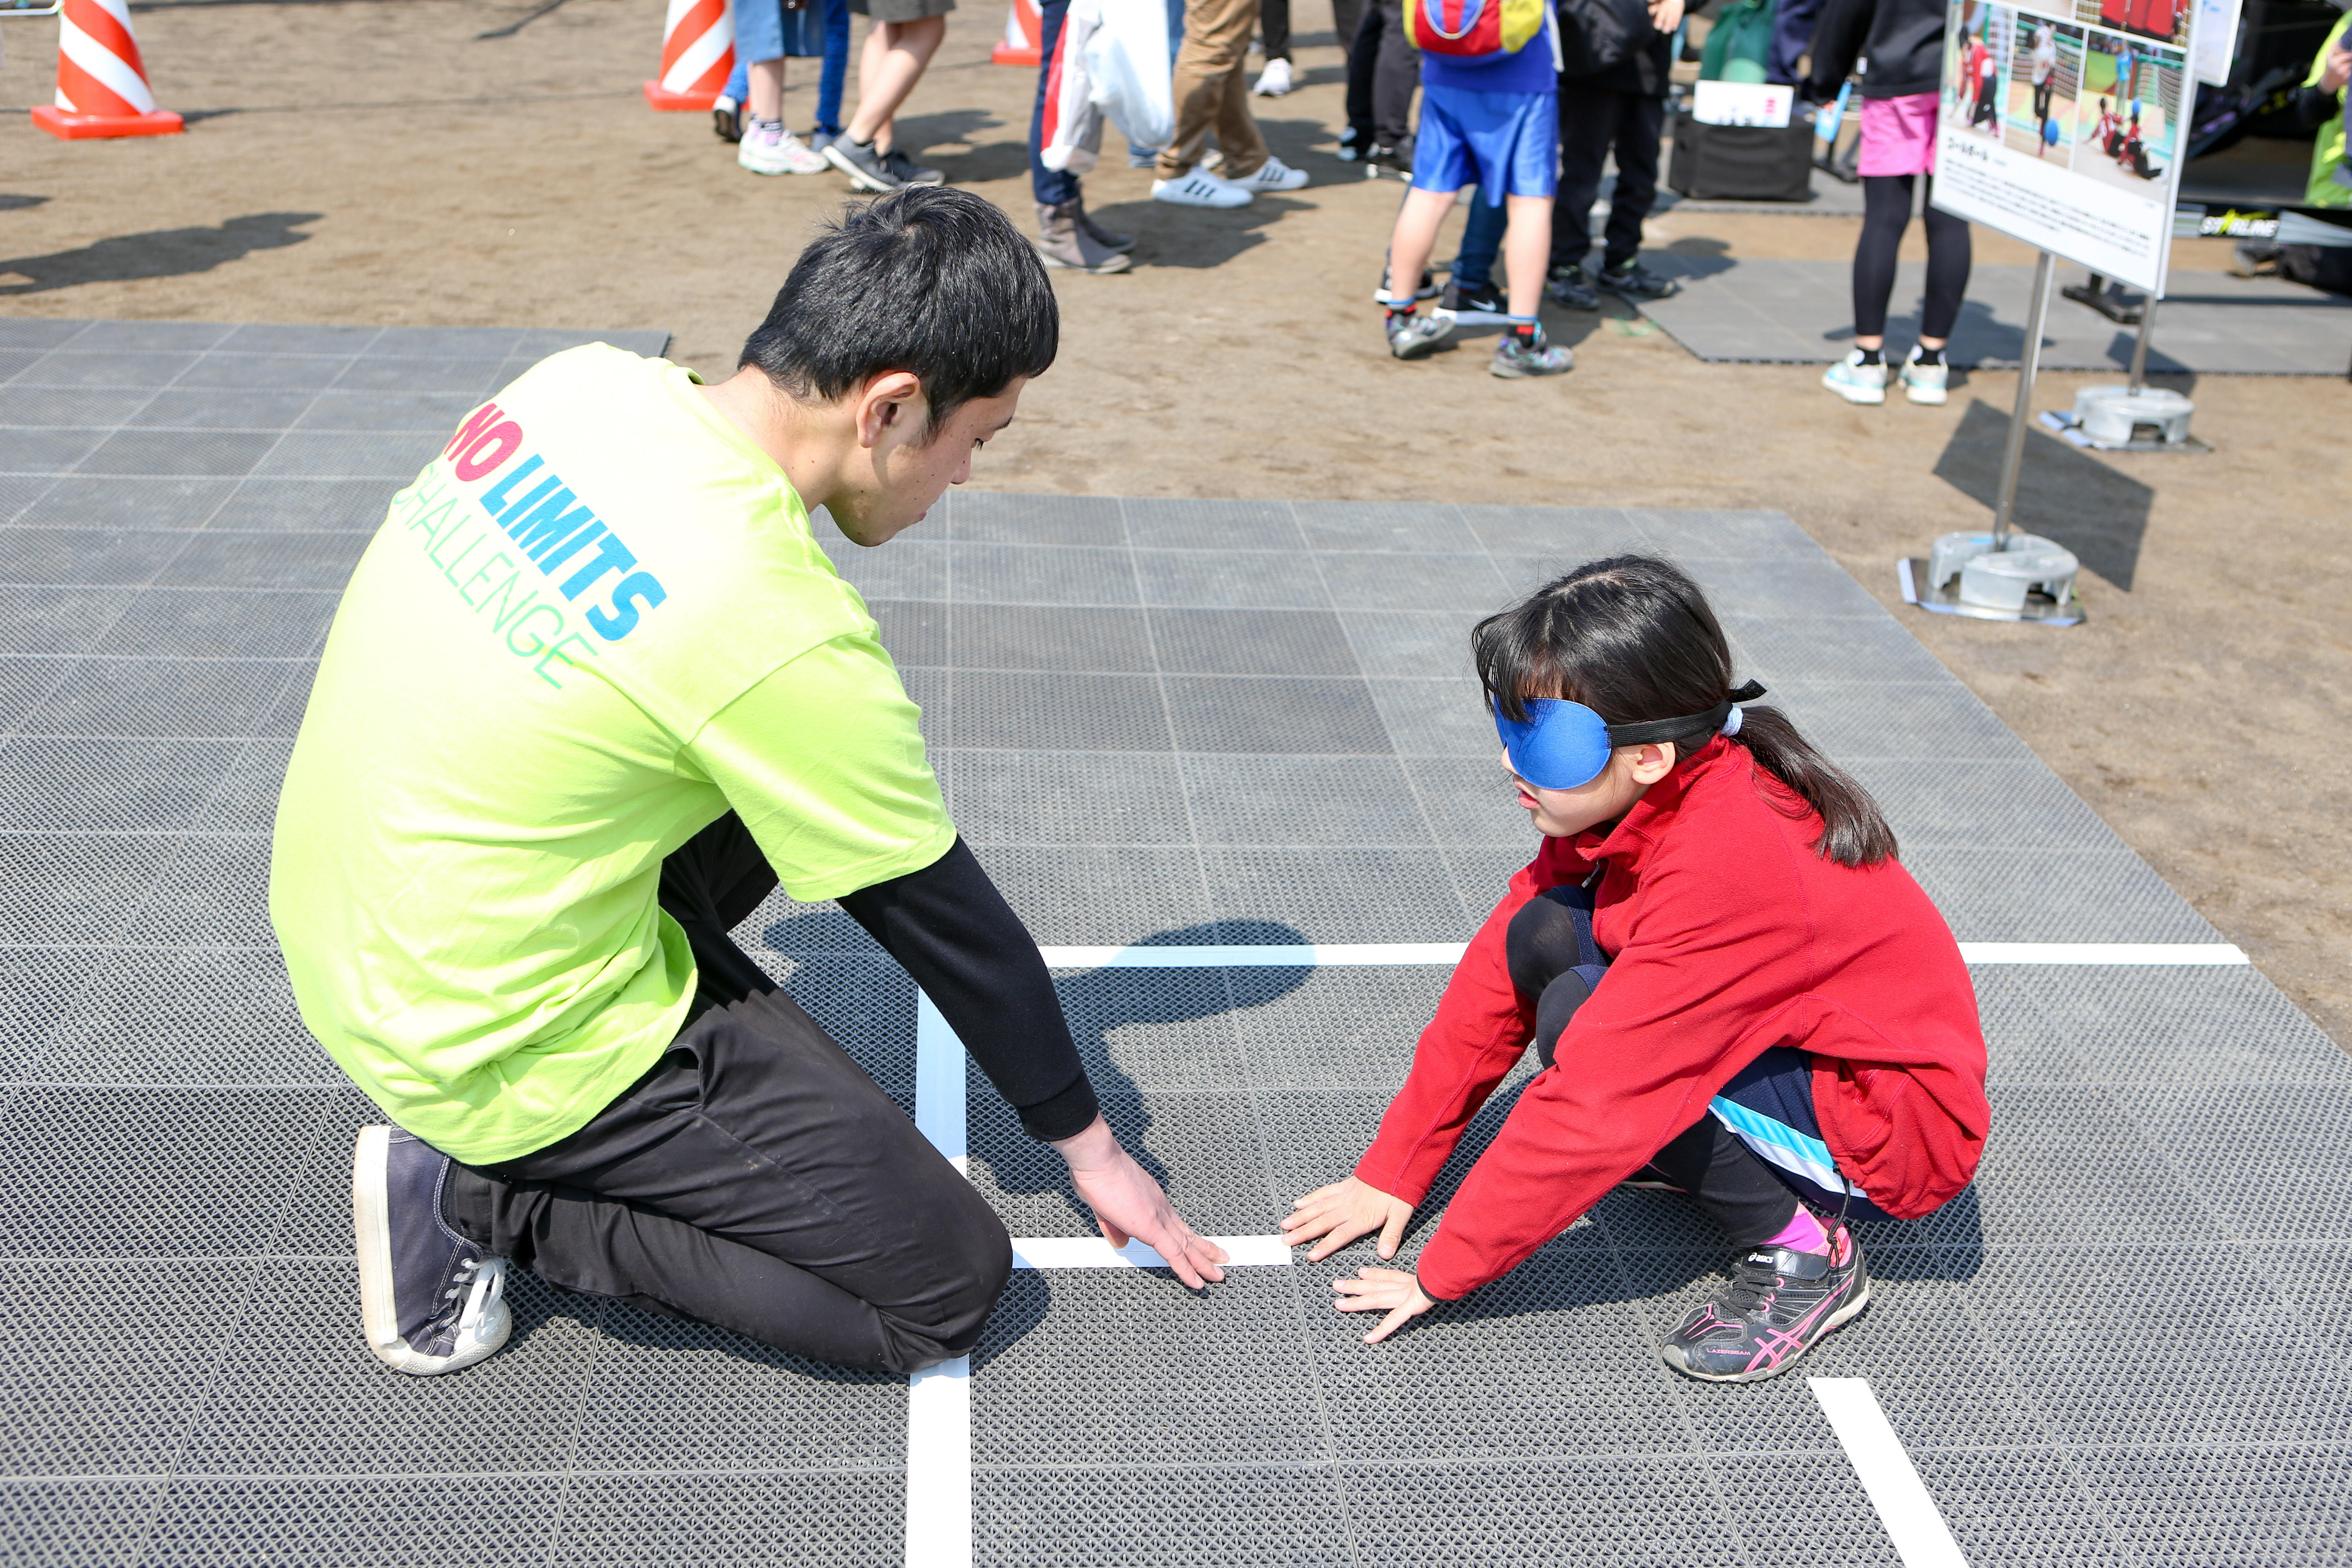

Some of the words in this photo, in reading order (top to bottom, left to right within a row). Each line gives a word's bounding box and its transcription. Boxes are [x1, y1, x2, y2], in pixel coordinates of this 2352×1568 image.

[443, 402, 523, 482] NO
[479, 453, 667, 641] LIMITS
[1755, 1254, 1774, 1264] asics
